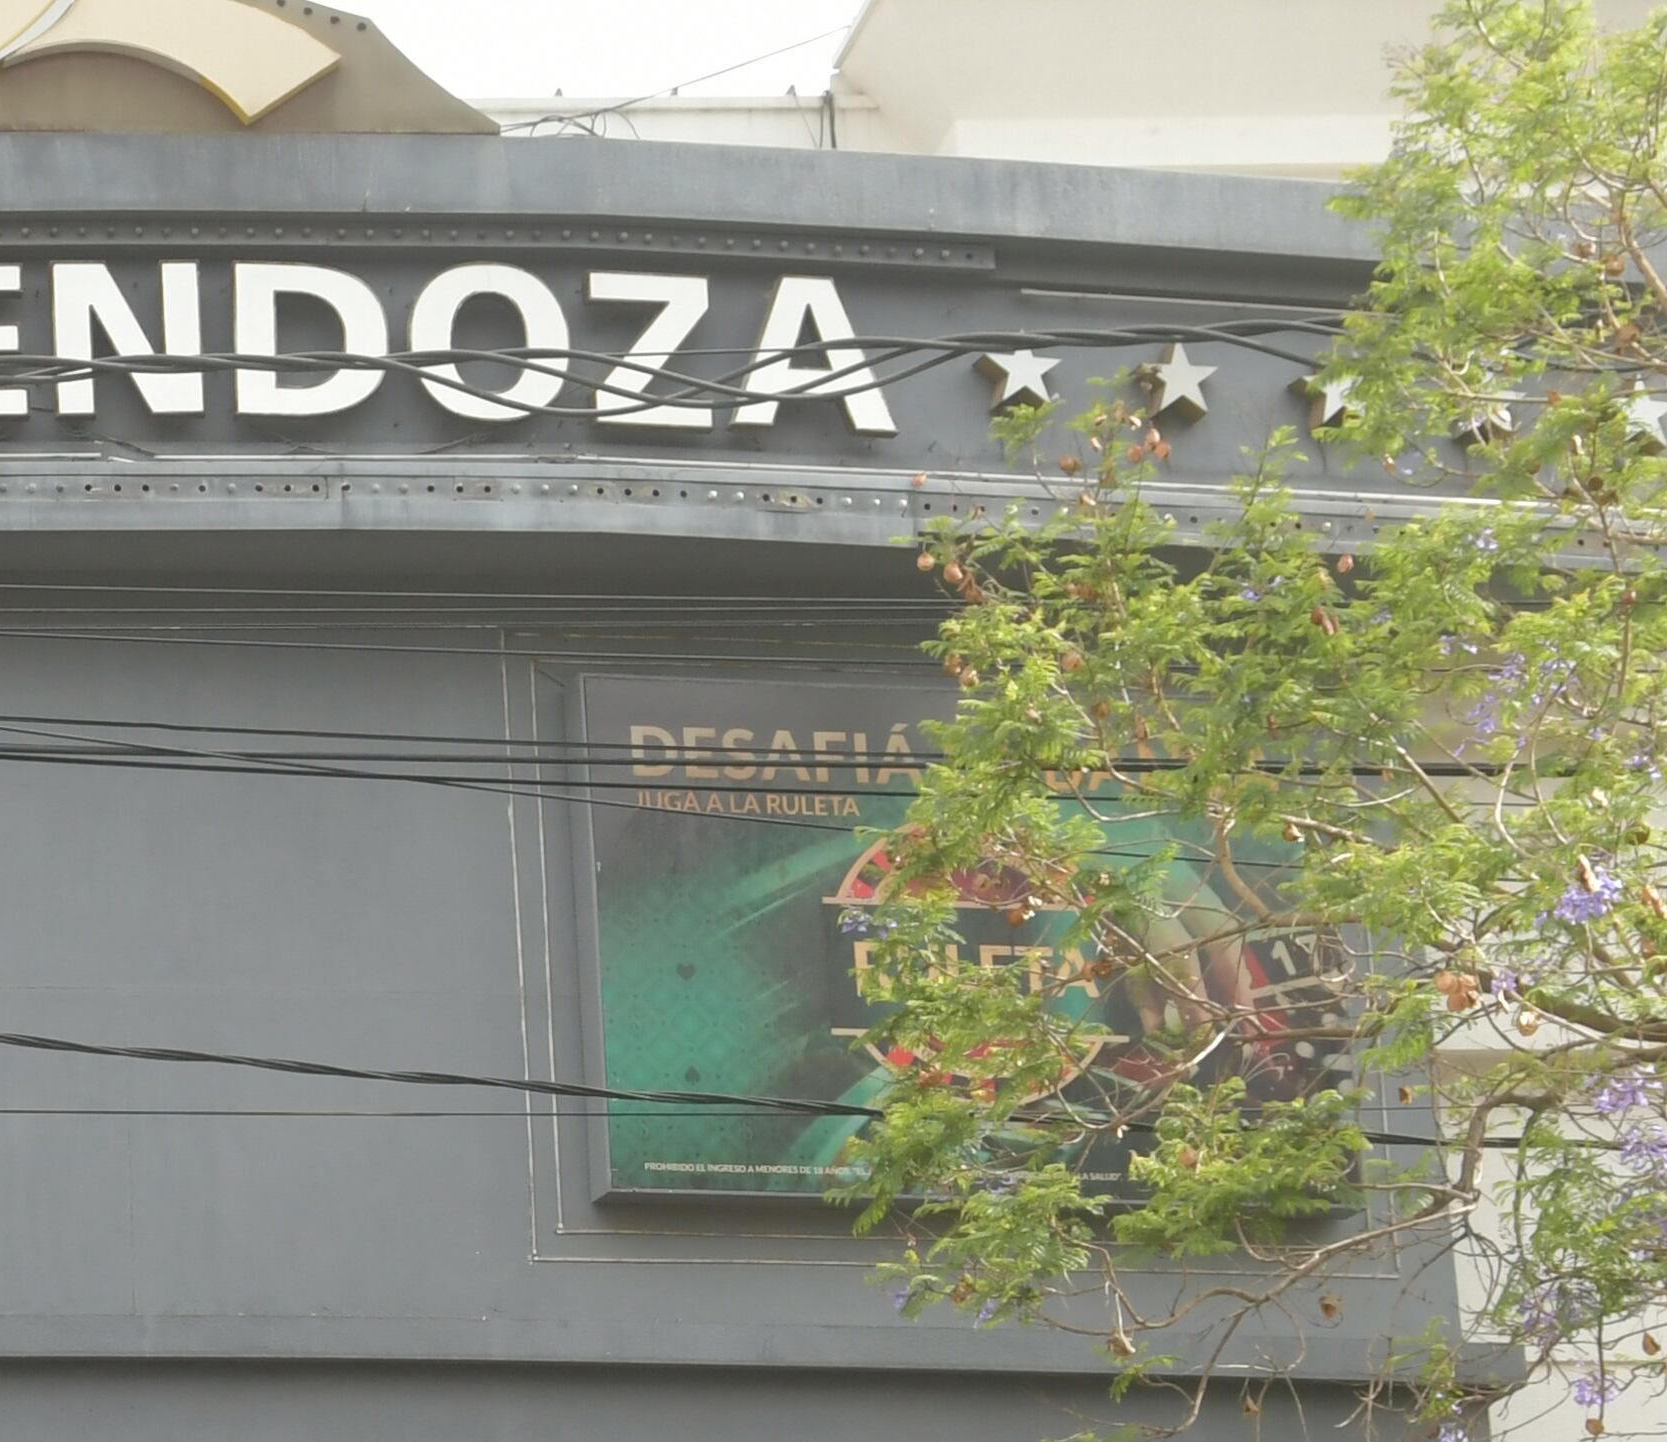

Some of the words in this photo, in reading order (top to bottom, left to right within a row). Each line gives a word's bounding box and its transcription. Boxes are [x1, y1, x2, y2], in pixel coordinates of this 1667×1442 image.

[629, 722, 924, 785] DESAFIÁ
[706, 795, 724, 813] A
[730, 795, 761, 815] LA
[769, 795, 860, 817] RULETA
